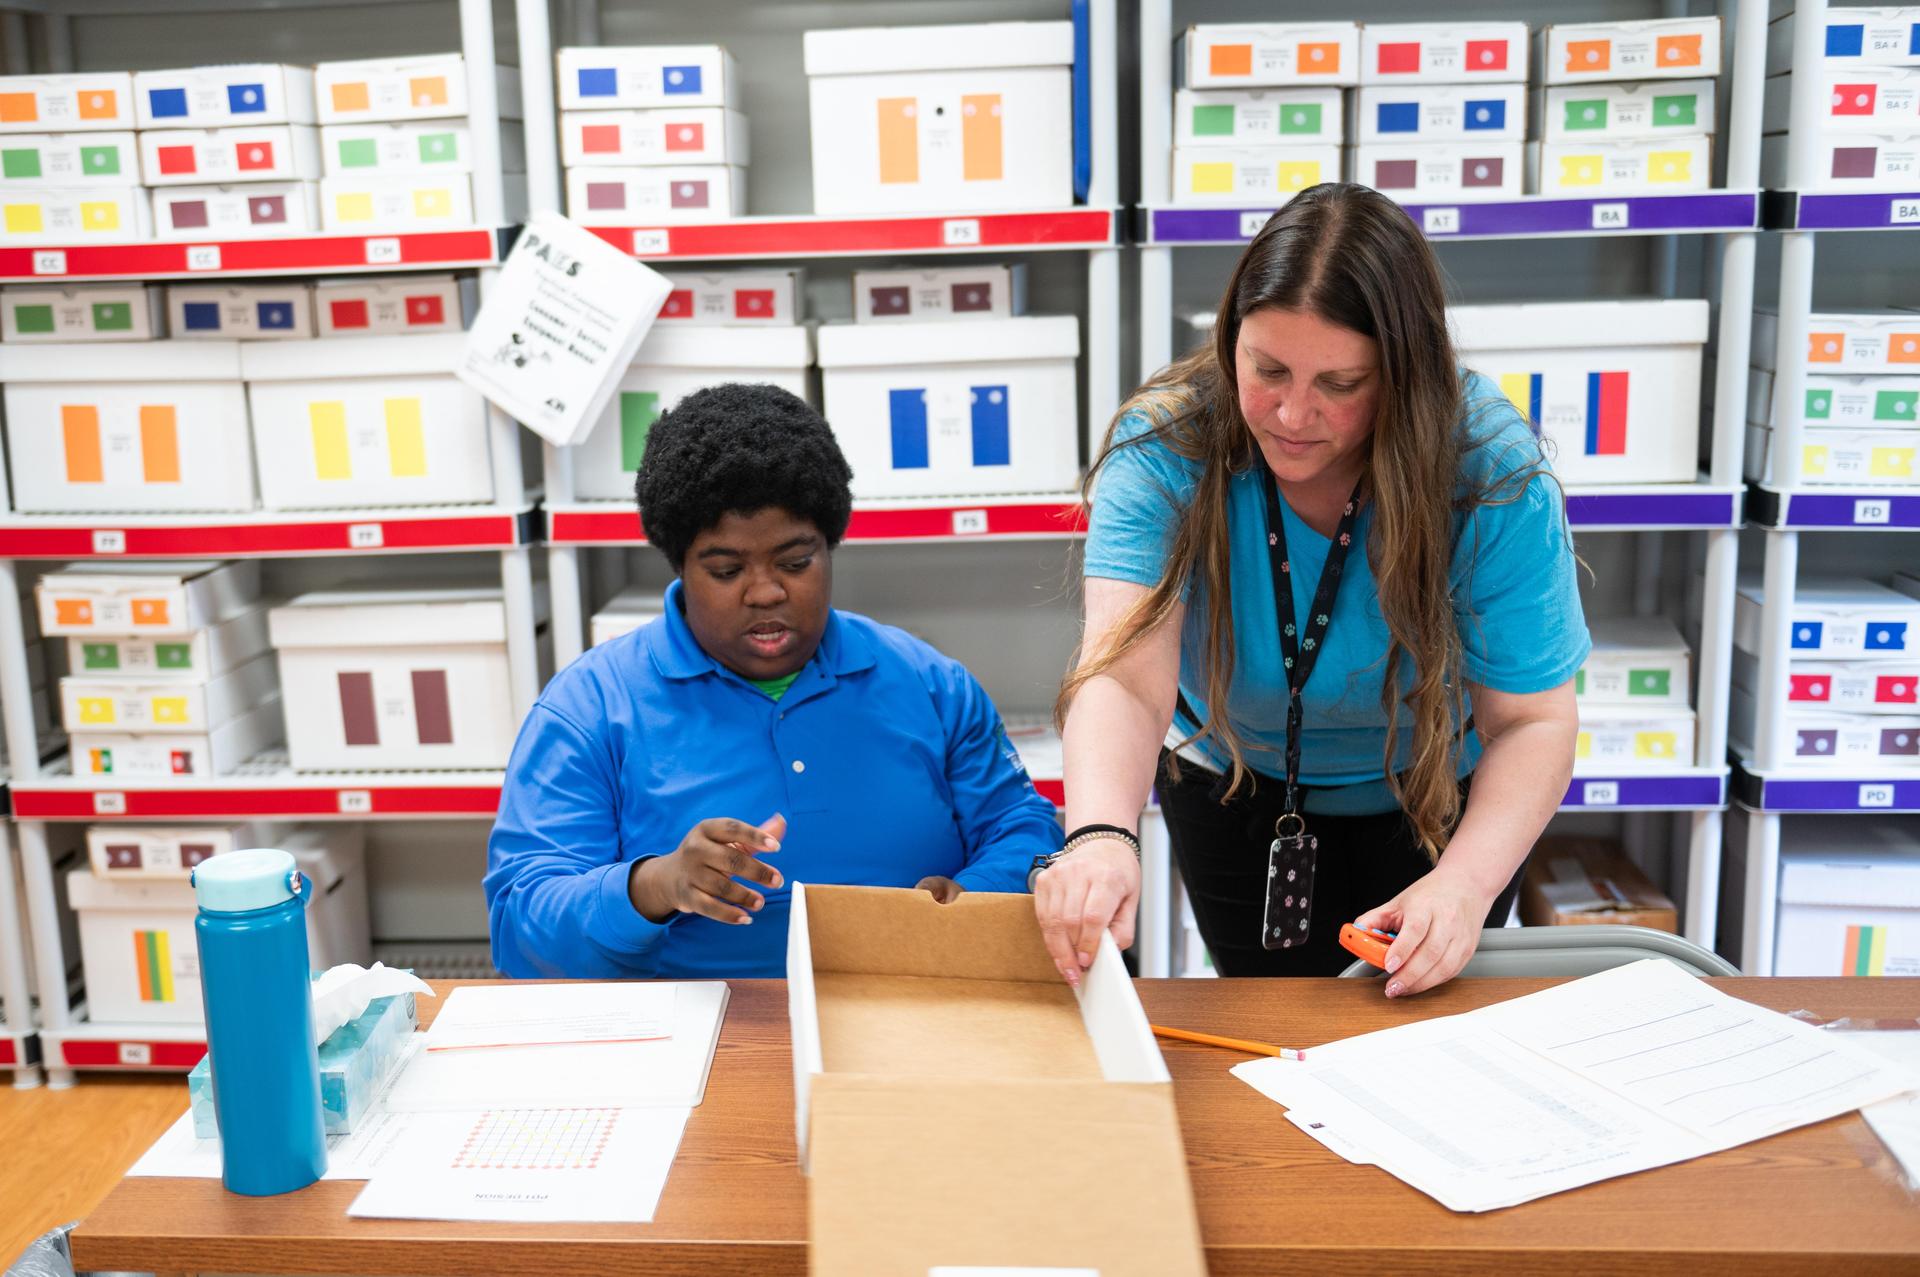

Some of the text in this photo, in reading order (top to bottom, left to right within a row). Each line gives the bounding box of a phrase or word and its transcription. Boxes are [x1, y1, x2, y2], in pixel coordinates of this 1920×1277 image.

[1874, 40, 1898, 50] BA 4
[1886, 100, 1909, 110] BA 5
[1887, 162, 1901, 172] BA
[1601, 211, 1620, 222] BA
[1899, 206, 1919, 217] BA
[1432, 216, 1450, 227] AT
[953, 227, 970, 238] FS
[1854, 348, 1869, 358] FD
[1842, 406, 1856, 415] FD
[1837, 461, 1851, 470] FD
[1863, 506, 1882, 517] FD
[962, 516, 978, 527] FS
[1591, 789, 1611, 799] PD
[1866, 790, 1886, 801] PD
